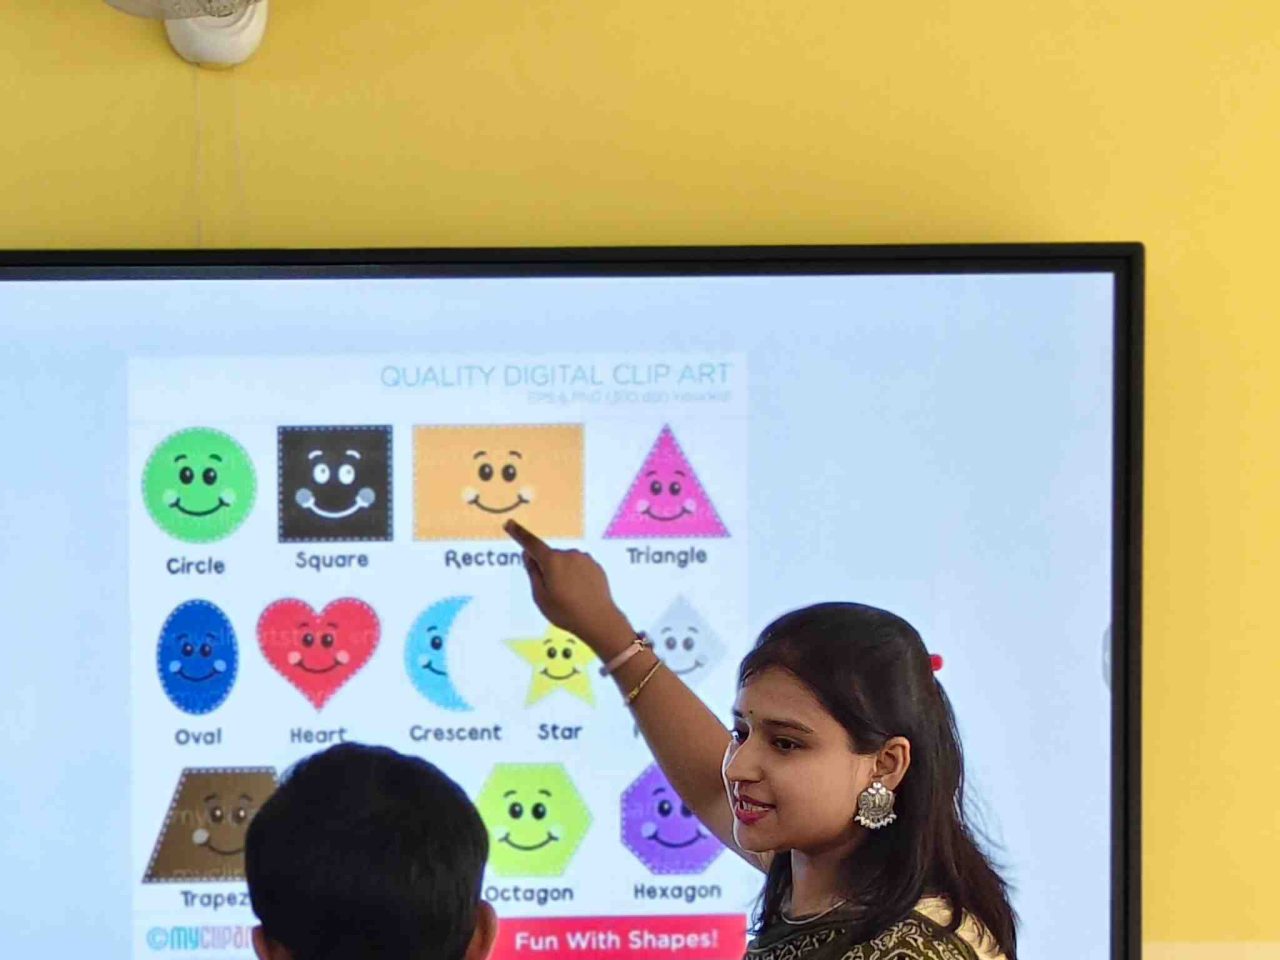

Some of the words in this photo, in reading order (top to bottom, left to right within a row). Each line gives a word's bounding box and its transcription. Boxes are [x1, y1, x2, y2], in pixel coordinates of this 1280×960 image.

[380, 364, 496, 388] QUALITY
[504, 363, 604, 386] DIGITAL
[612, 363, 671, 386] CLIP
[677, 362, 732, 385] ART
[166, 556, 226, 577] Circle
[295, 551, 370, 573] Square
[444, 549, 524, 569] Rectan
[627, 546, 708, 569] Triangle
[175, 728, 223, 747] Oval
[290, 727, 347, 745] Heart
[409, 724, 502, 743] Crescent
[537, 723, 583, 742] Star
[181, 890, 250, 911] Trapez
[484, 886, 574, 906] Octagon
[633, 884, 722, 904] Hexagon
[515, 932, 558, 951] Fun
[567, 931, 621, 951] With
[628, 929, 719, 955] Shapes!
